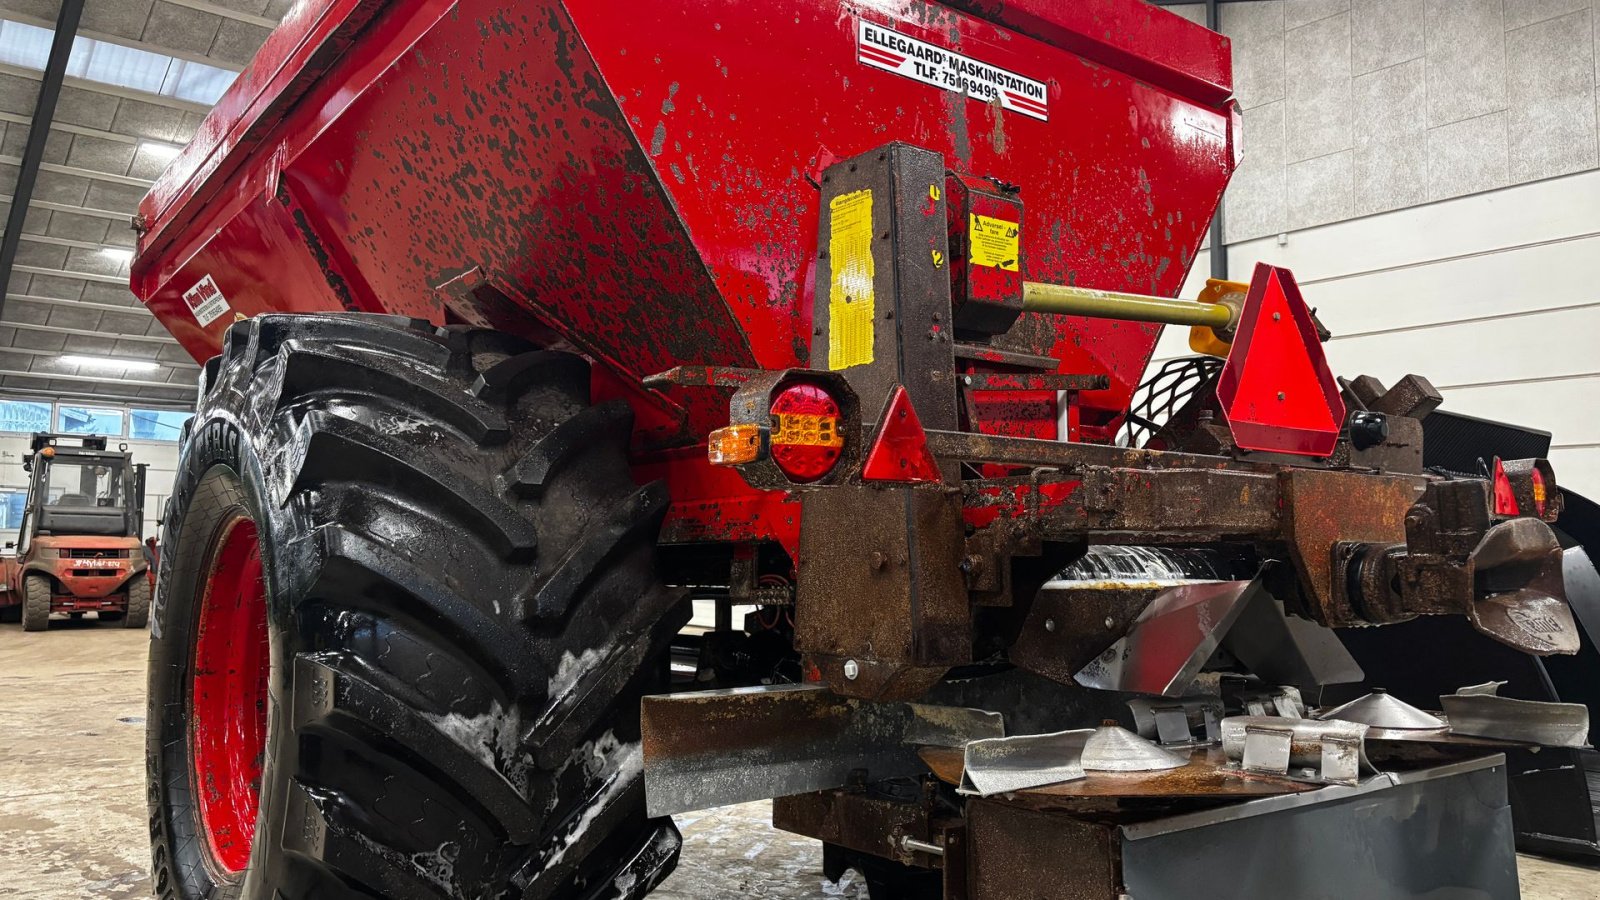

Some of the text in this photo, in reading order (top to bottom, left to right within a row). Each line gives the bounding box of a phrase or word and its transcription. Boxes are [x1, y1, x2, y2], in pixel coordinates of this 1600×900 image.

[914, 61, 998, 99] TLF. 75169499
[949, 56, 1043, 99] MASKINSTATION
